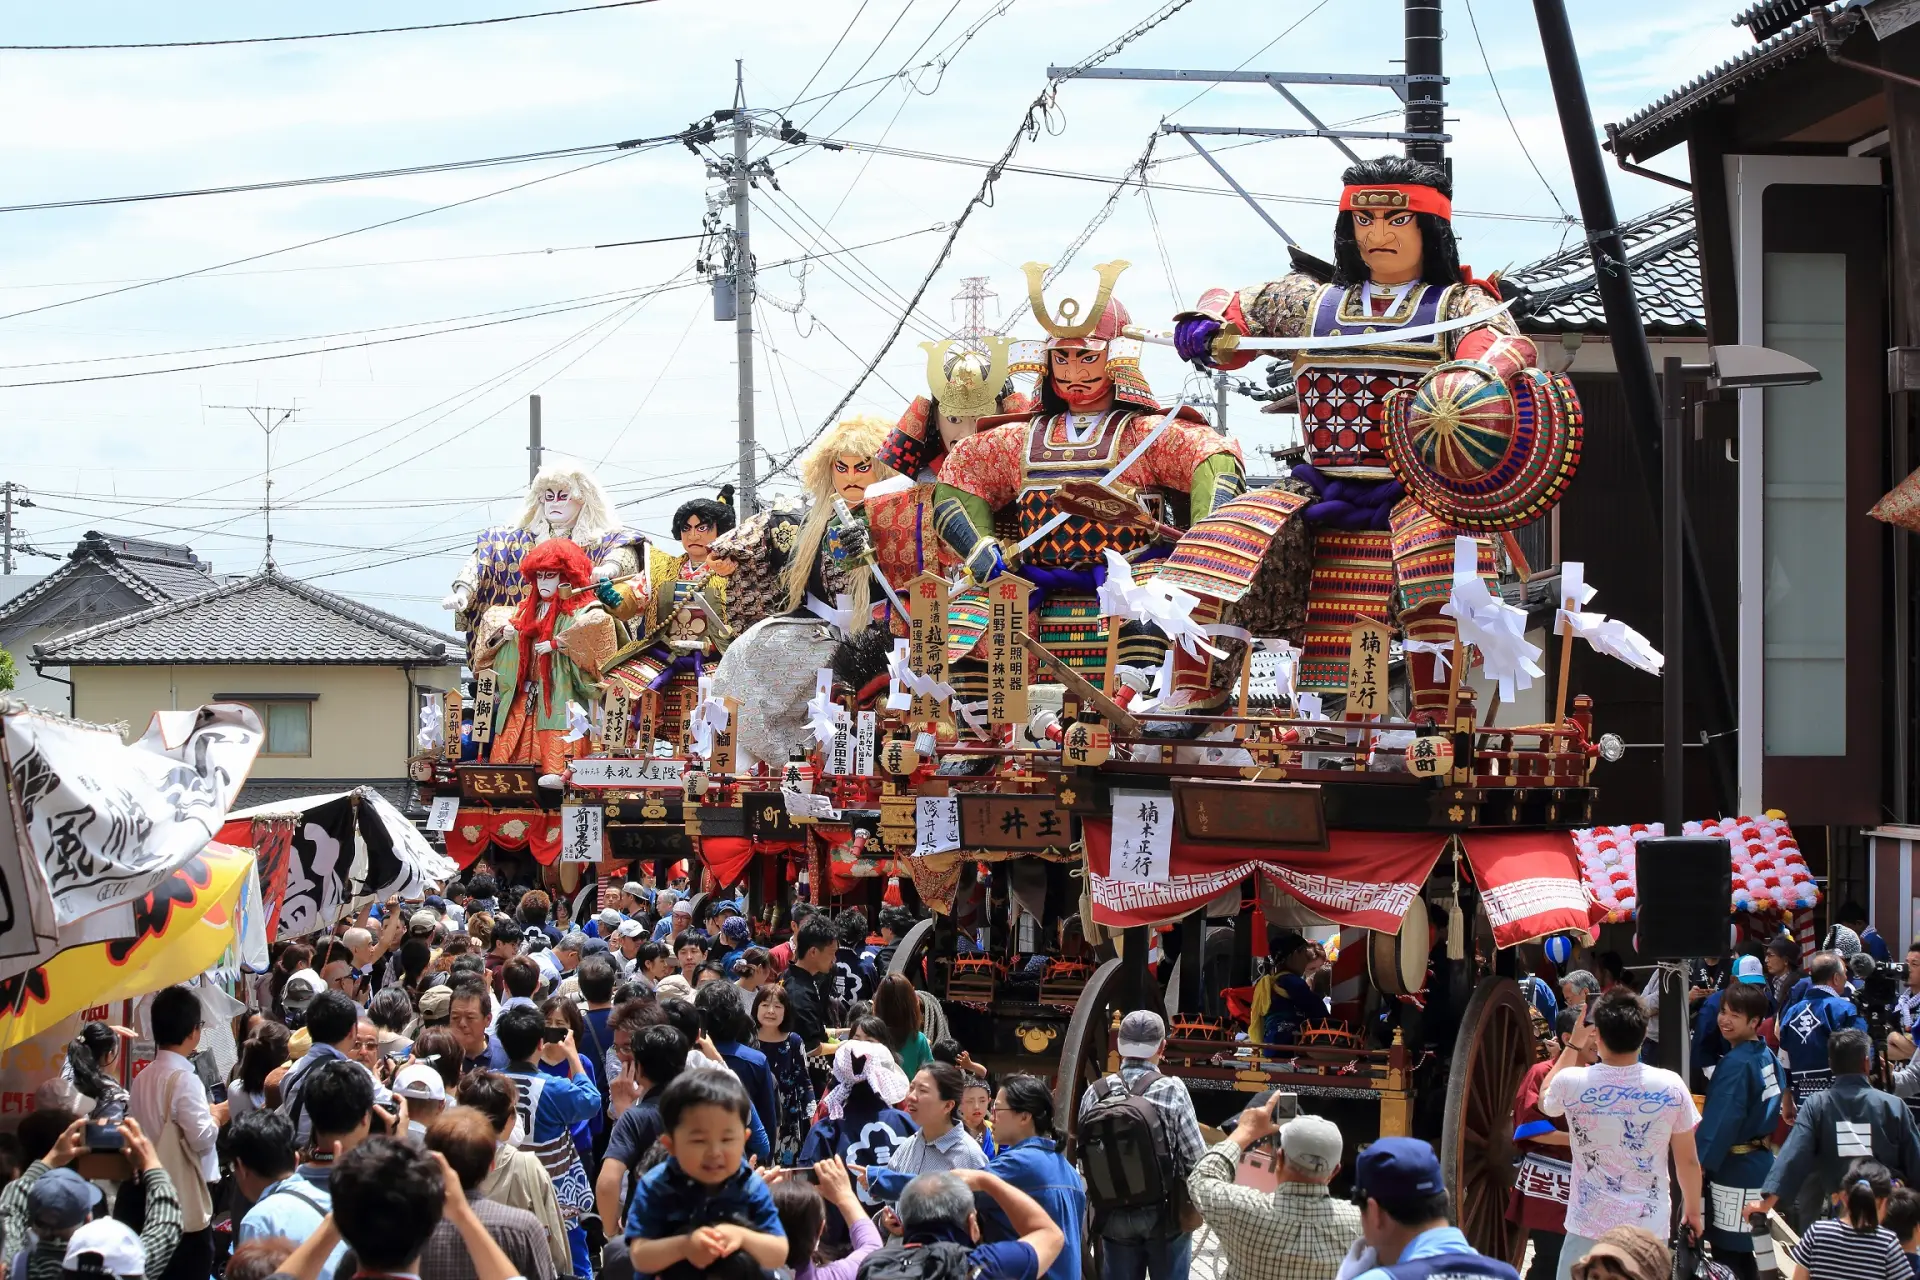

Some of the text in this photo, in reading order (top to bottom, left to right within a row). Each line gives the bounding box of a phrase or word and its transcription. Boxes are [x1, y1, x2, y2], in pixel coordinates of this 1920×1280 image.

[920, 583, 937, 599] 祝
[1000, 584, 1018, 600] 祝
[992, 604, 1006, 719] 日野電子株式会社
[1356, 631, 1381, 710] 楠木正行
[448, 704, 460, 755] 二の部地区
[474, 678, 493, 738] 連獅子
[834, 723, 848, 775] 明治安田生命
[1070, 726, 1090, 762] 森町
[1414, 738, 1437, 772] 森町
[1000, 807, 1061, 839] 玉井
[1130, 801, 1159, 877] 楠木正行
